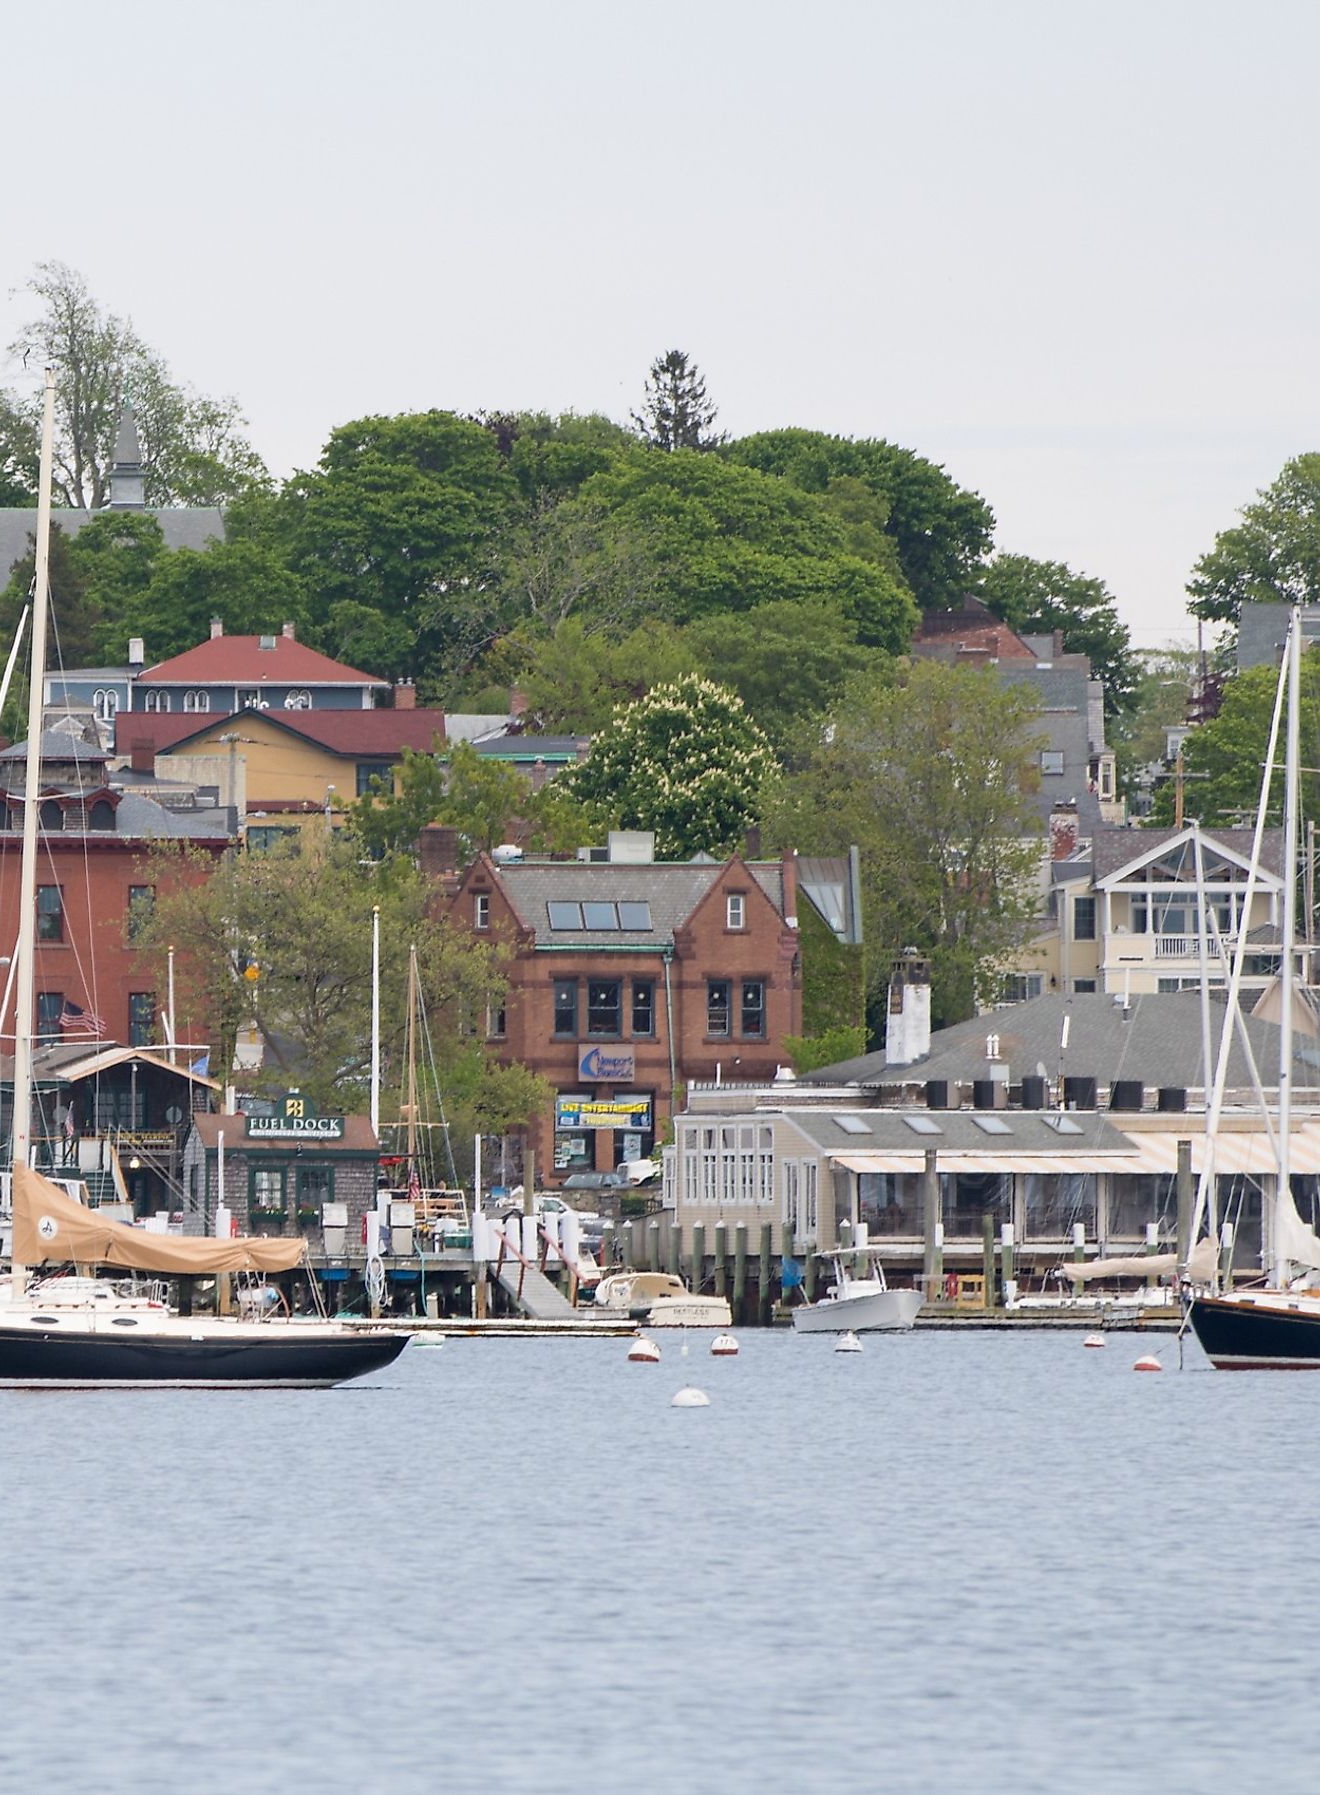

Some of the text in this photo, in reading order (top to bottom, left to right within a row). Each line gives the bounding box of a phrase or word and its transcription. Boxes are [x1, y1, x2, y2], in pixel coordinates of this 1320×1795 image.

[561, 1102, 648, 1114] LIVE ENTERTAINMENT
[250, 1118, 339, 1130] FUEL DOCK
